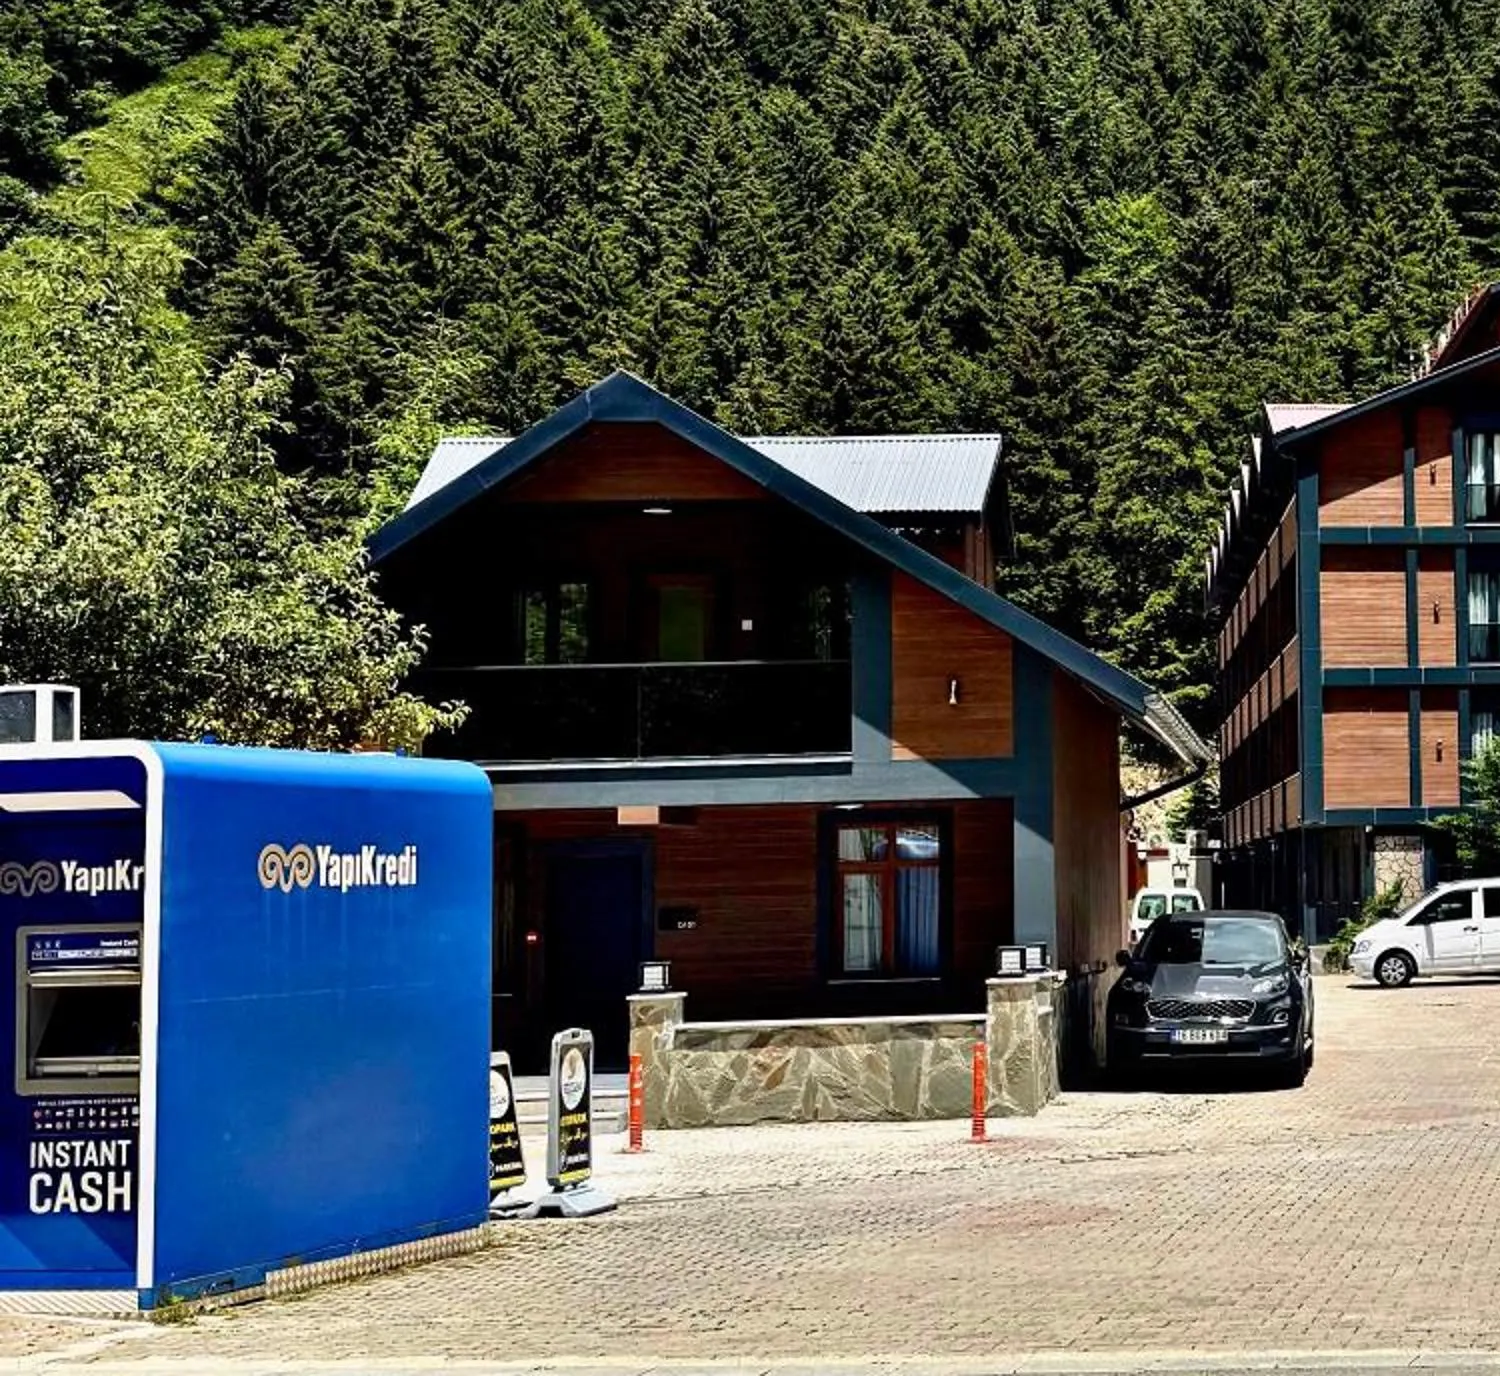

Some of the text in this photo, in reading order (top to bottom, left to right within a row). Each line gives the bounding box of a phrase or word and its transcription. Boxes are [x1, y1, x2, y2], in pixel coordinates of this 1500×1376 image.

[316, 845, 417, 893] YapıKredi
[30, 1140, 132, 1169] INSTANT
[29, 1171, 131, 1215] CASH
